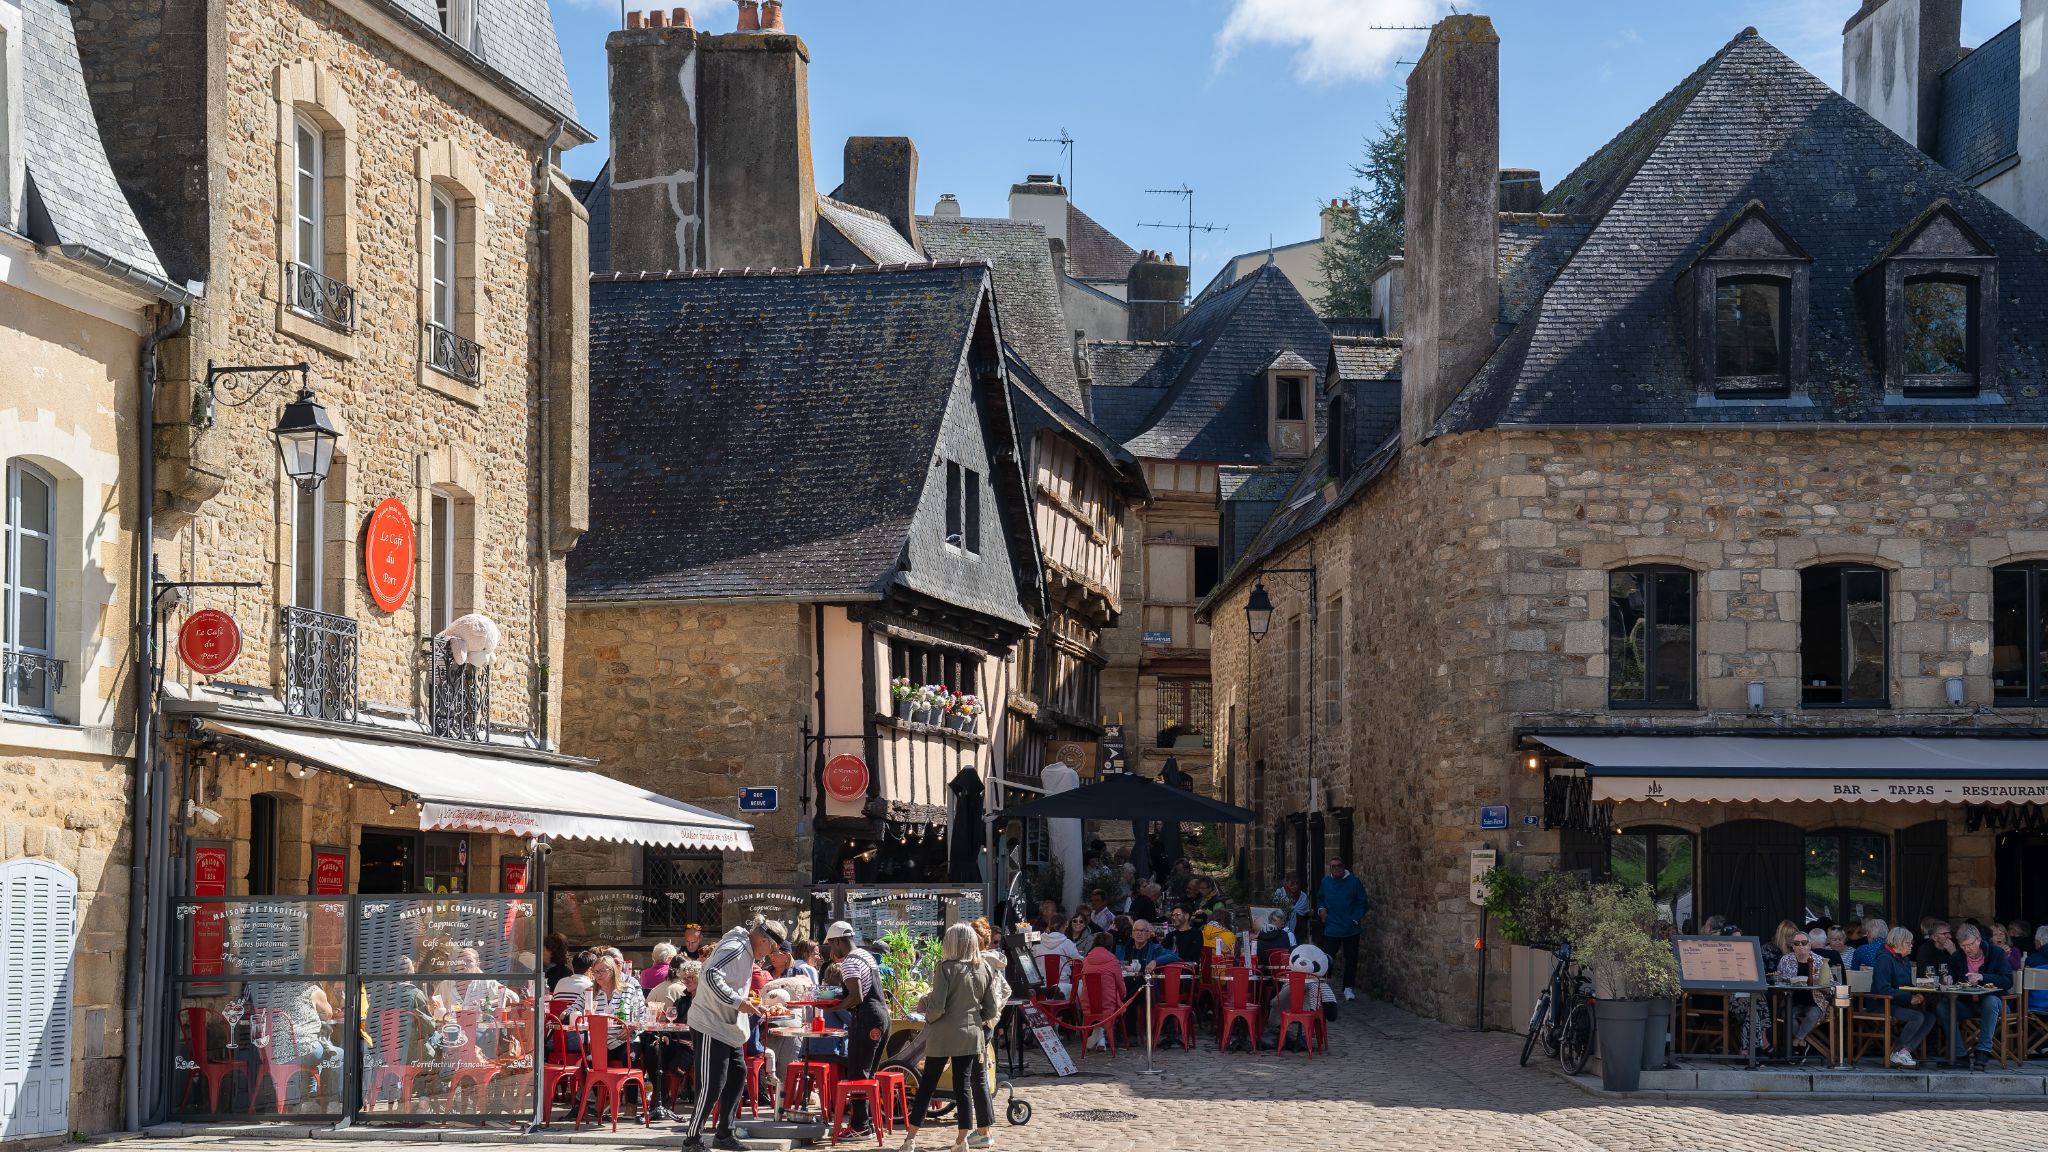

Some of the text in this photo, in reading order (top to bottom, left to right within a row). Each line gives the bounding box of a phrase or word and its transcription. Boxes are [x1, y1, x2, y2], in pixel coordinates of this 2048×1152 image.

[380, 530, 404, 550] Le Café
[386, 551, 394, 564] du
[382, 572, 397, 586] Port
[206, 626, 224, 638] Café
[204, 639, 215, 648] du
[200, 652, 219, 660] Port
[1834, 785, 1862, 795] BAR
[1888, 785, 1934, 795] TAPAS
[583, 894, 608, 905] MAISON
[622, 893, 658, 904] TRADITION
[728, 894, 753, 904] MAISON
[767, 892, 804, 904] CONFIANCE
[871, 895, 898, 906] MAISON
[213, 908, 246, 921] MAISON
[262, 905, 309, 920] TRADITION
[400, 906, 433, 920] MAISON
[450, 905, 498, 919] CONFIANCE
[229, 924, 242, 935] Jus
[243, 921, 250, 930] de
[250, 922, 280, 932] pommes
[281, 923, 292, 932] bio
[428, 920, 469, 930] Cappuccino
[255, 939, 288, 948] bretonnes
[422, 939, 438, 950] Café
[445, 938, 473, 947] chocolat
[221, 953, 236, 964] Thé
[261, 952, 299, 967] citronnade
[431, 957, 445, 966] Tea
[411, 1059, 485, 1072] Torréfacteur français
